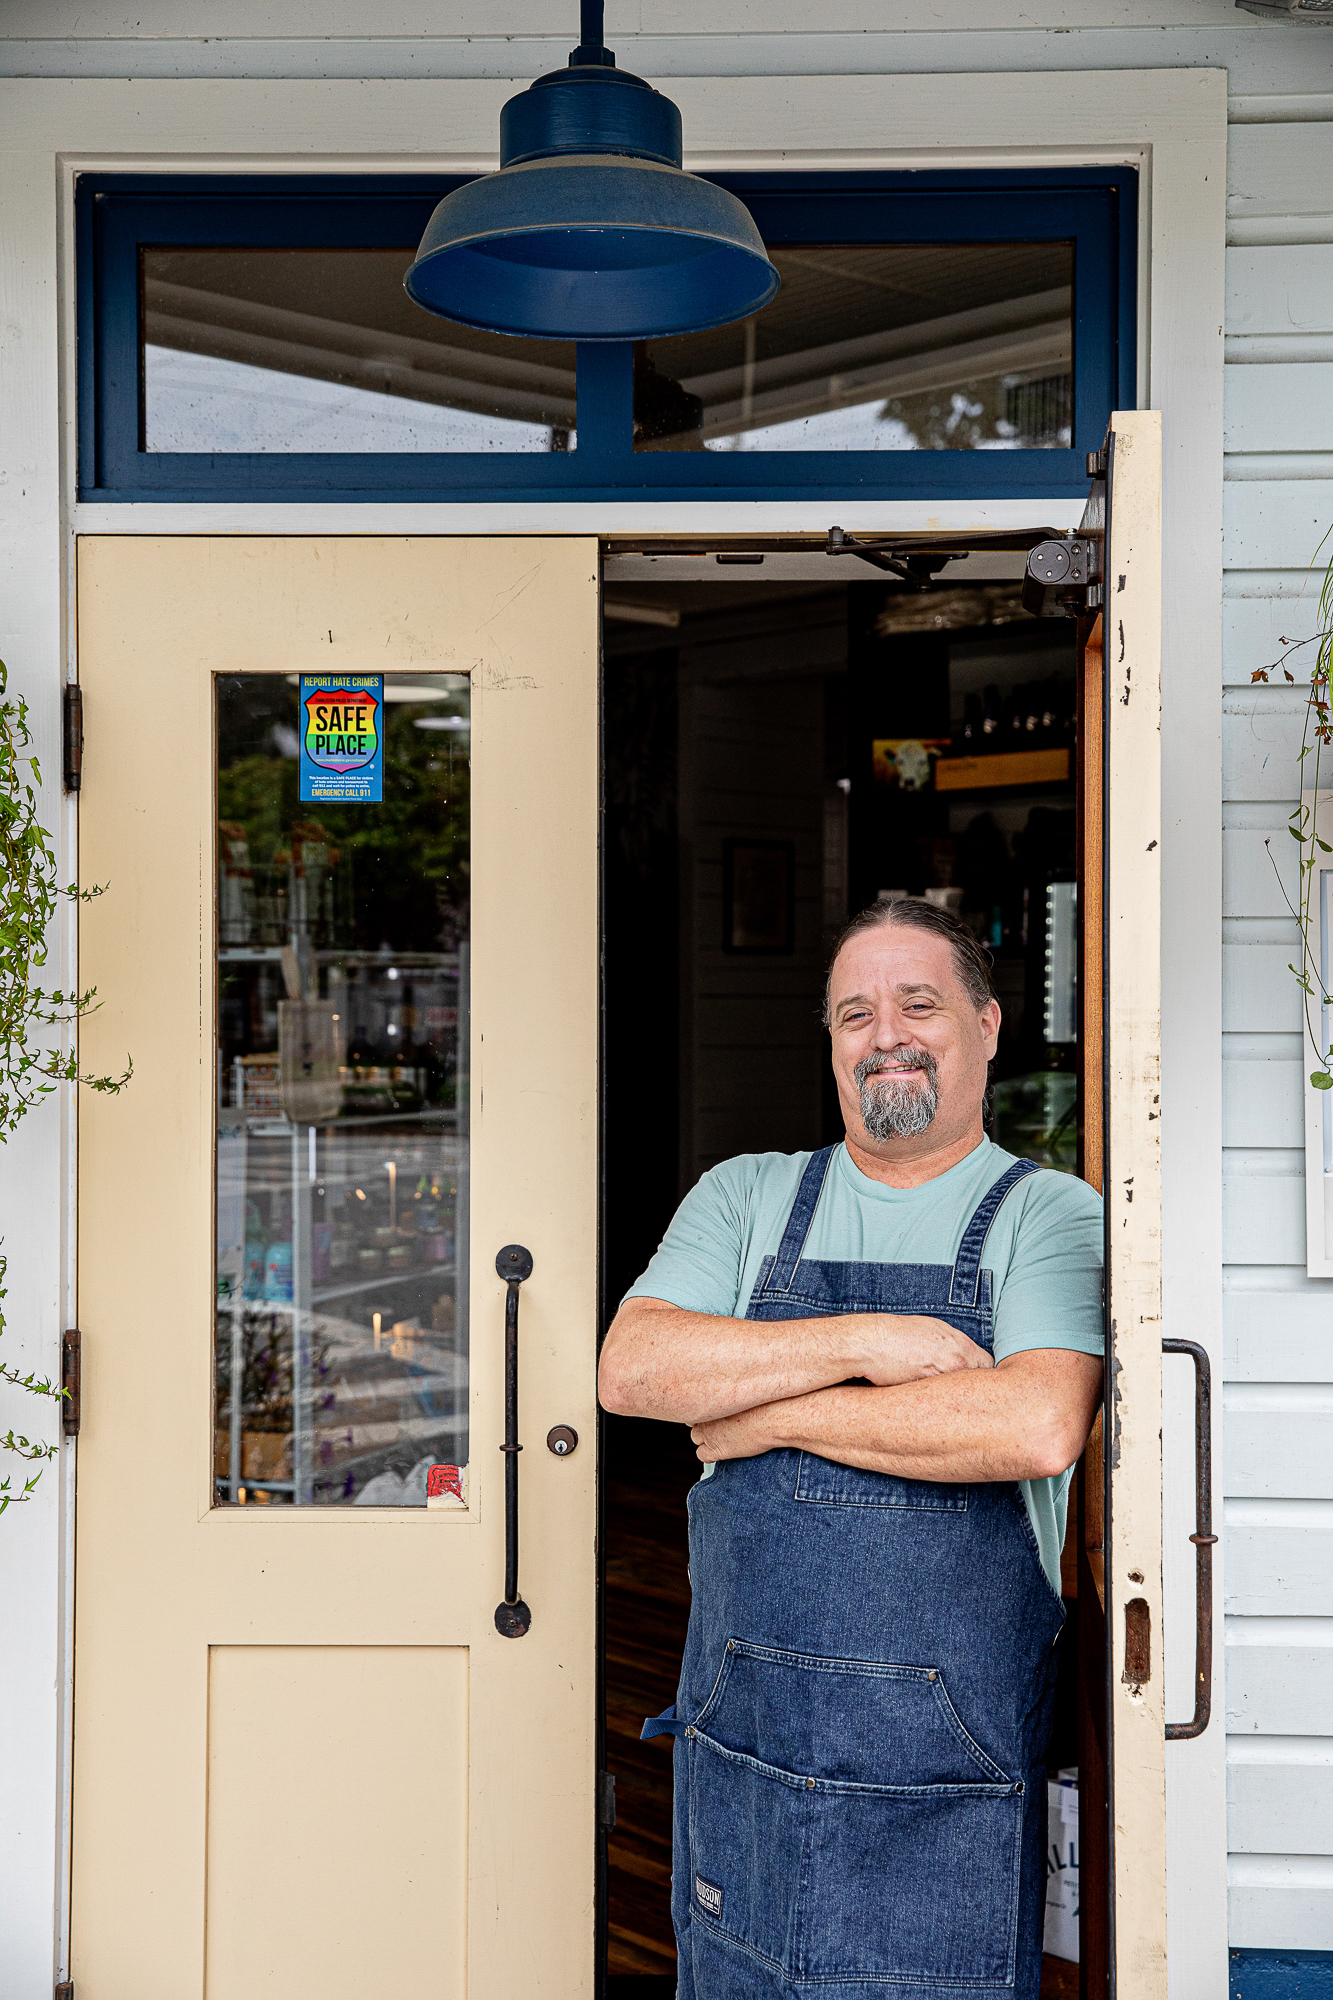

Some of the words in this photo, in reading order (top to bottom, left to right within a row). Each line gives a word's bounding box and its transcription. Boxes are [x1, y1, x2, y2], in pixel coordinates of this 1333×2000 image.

[304, 677, 331, 687] REPORT
[333, 677, 351, 687] HATE
[352, 677, 379, 687] CRIMES
[316, 706, 367, 732] SAFE
[316, 735, 367, 755] PLACE
